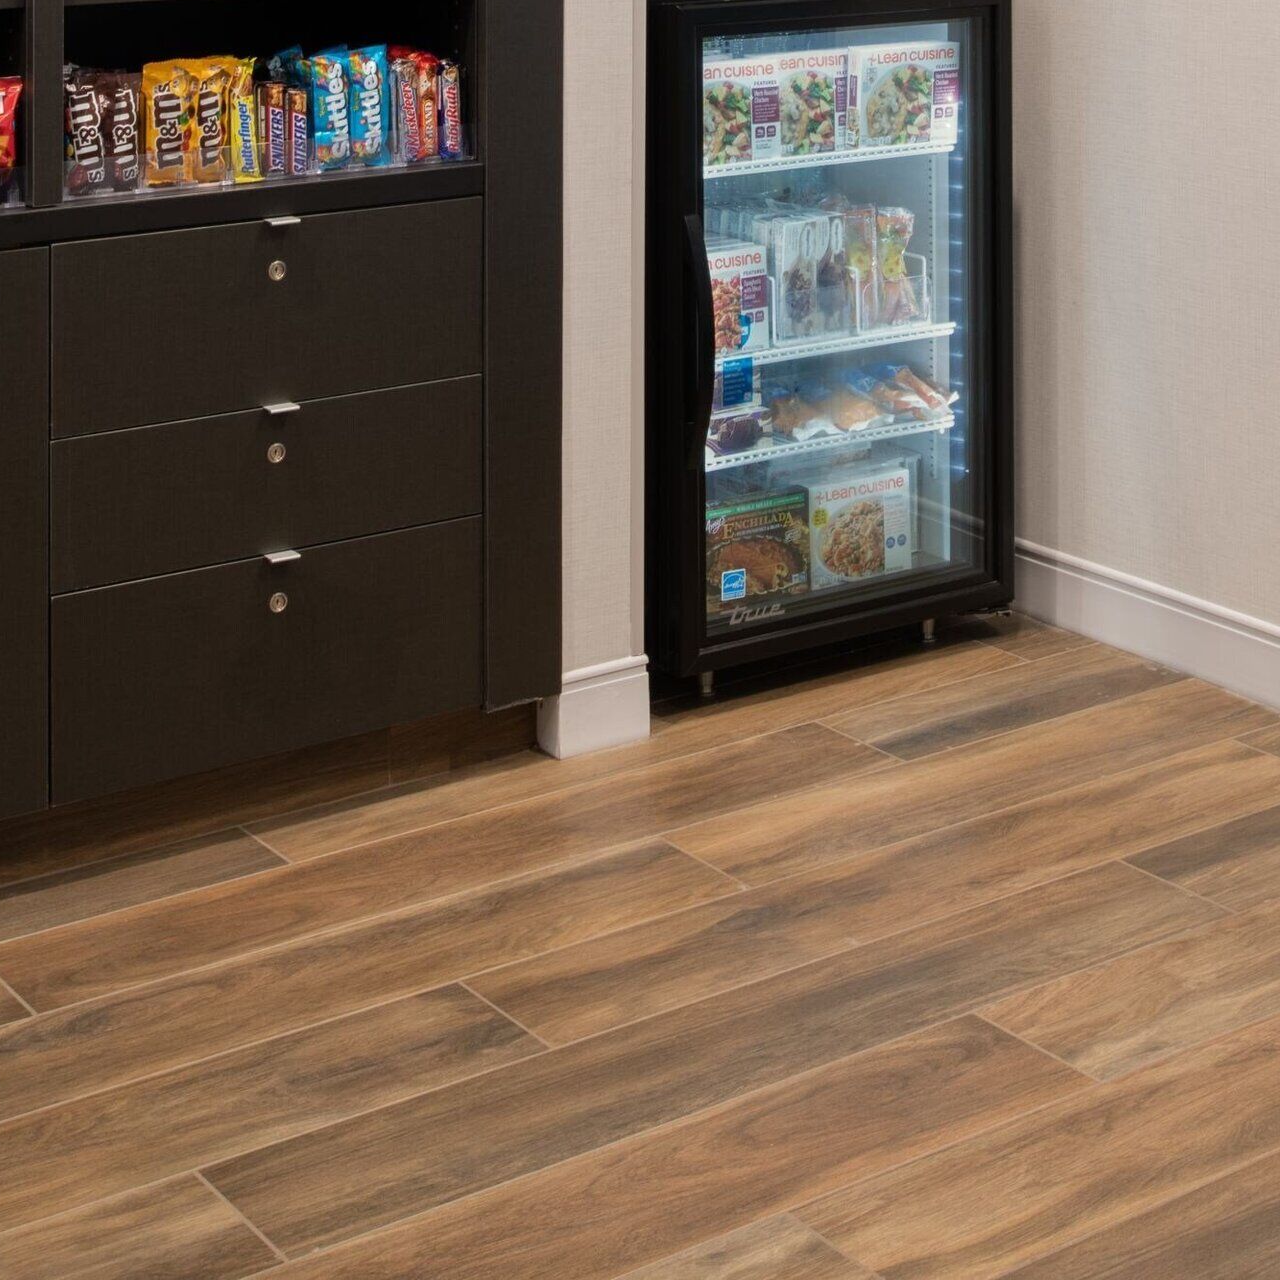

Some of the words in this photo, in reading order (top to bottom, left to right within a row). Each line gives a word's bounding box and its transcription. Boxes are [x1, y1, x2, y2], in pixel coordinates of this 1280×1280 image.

[780, 58, 805, 70] ean
[807, 54, 847, 68] cuisin
[877, 51, 908, 65] Lean
[909, 48, 955, 61] cuisine
[723, 63, 774, 78] cuisine
[325, 63, 350, 157] Skittles
[360, 60, 381, 154] Skittles
[402, 81, 419, 148] Musketeers
[237, 100, 254, 173] Butterfinger
[271, 109, 284, 173] SNICKERS
[294, 114, 306, 173] SATISFIES
[714, 252, 761, 269] cuisine
[825, 486, 858, 502] Lean
[859, 476, 904, 496] cuisine
[706, 515, 726, 534] Amy's
[722, 512, 793, 539] ENCHILADA
